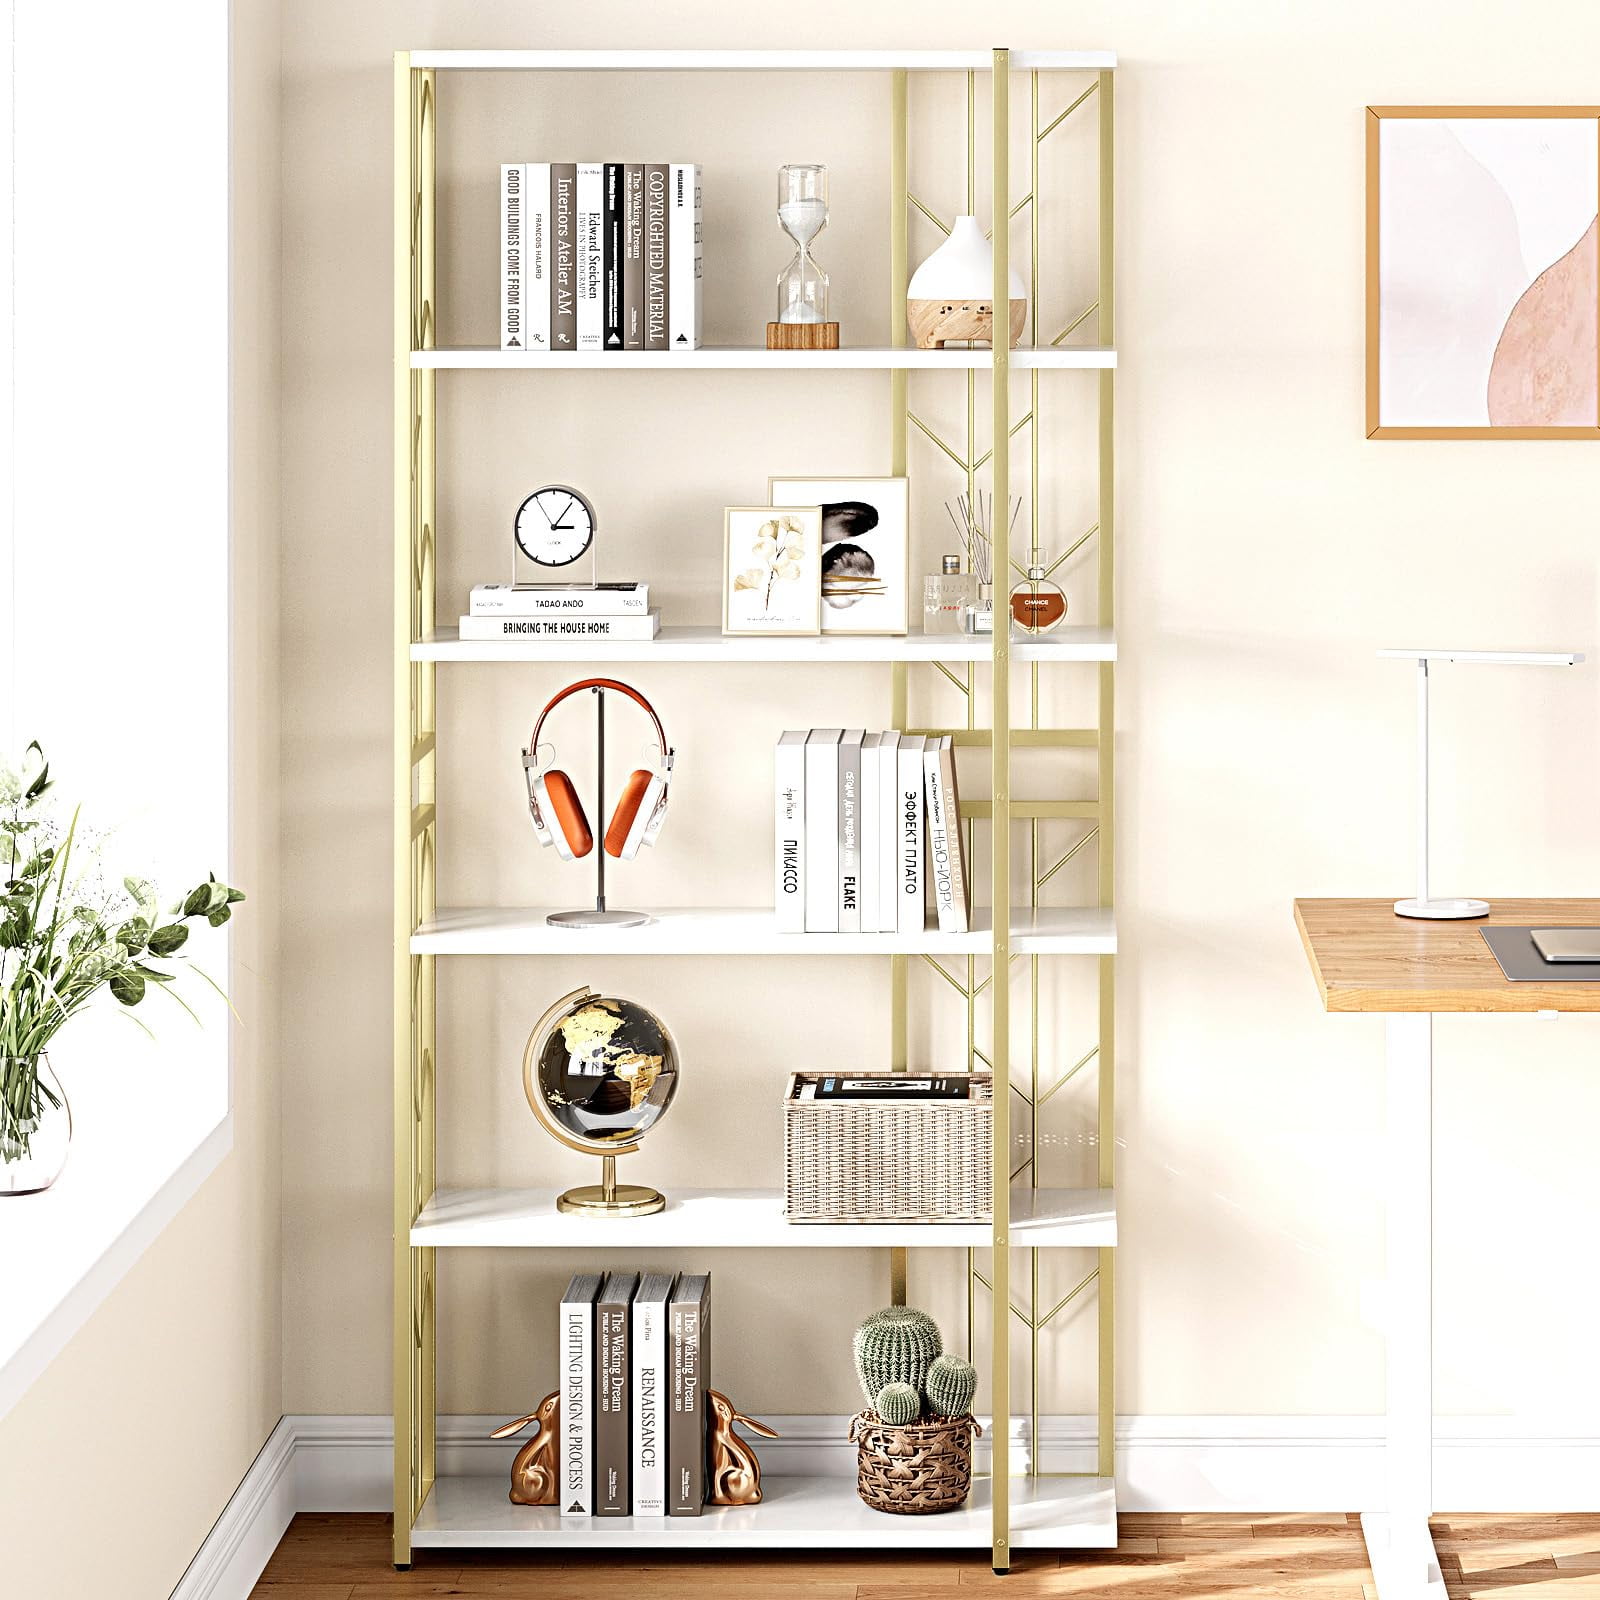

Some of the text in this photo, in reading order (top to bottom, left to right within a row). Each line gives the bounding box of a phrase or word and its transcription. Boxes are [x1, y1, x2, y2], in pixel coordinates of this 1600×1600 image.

[507, 169, 520, 334] GOOD BUILDINGS COME FROM GOOD
[557, 178, 573, 316] Interiors Atelier AM
[578, 212, 587, 233] LIVES
[578, 234, 587, 243] IN
[588, 212, 601, 300] Edward Steichen
[632, 171, 643, 259] The Waking Dream
[649, 171, 665, 342] COPYRIGHTED MATERIAL
[503, 622, 610, 634] BRINGING THE HOUSE HOME
[535, 600, 584, 608] TADAO ANDO
[904, 791, 918, 895] ЭФФЕКТ ПЛАТО
[944, 787, 955, 821] РОСС
[783, 839, 798, 894] ПИКАССО
[843, 876, 856, 910] FLAKE
[933, 829, 954, 912] НЬЮ-ЙОРК
[568, 1313, 584, 1492] LIGHTING DESIGN & PROCESS
[608, 1311, 625, 1413] The Waking Dream
[681, 1311, 698, 1413] The Waking Dream
[641, 1367, 656, 1469] RENAISSANCE
